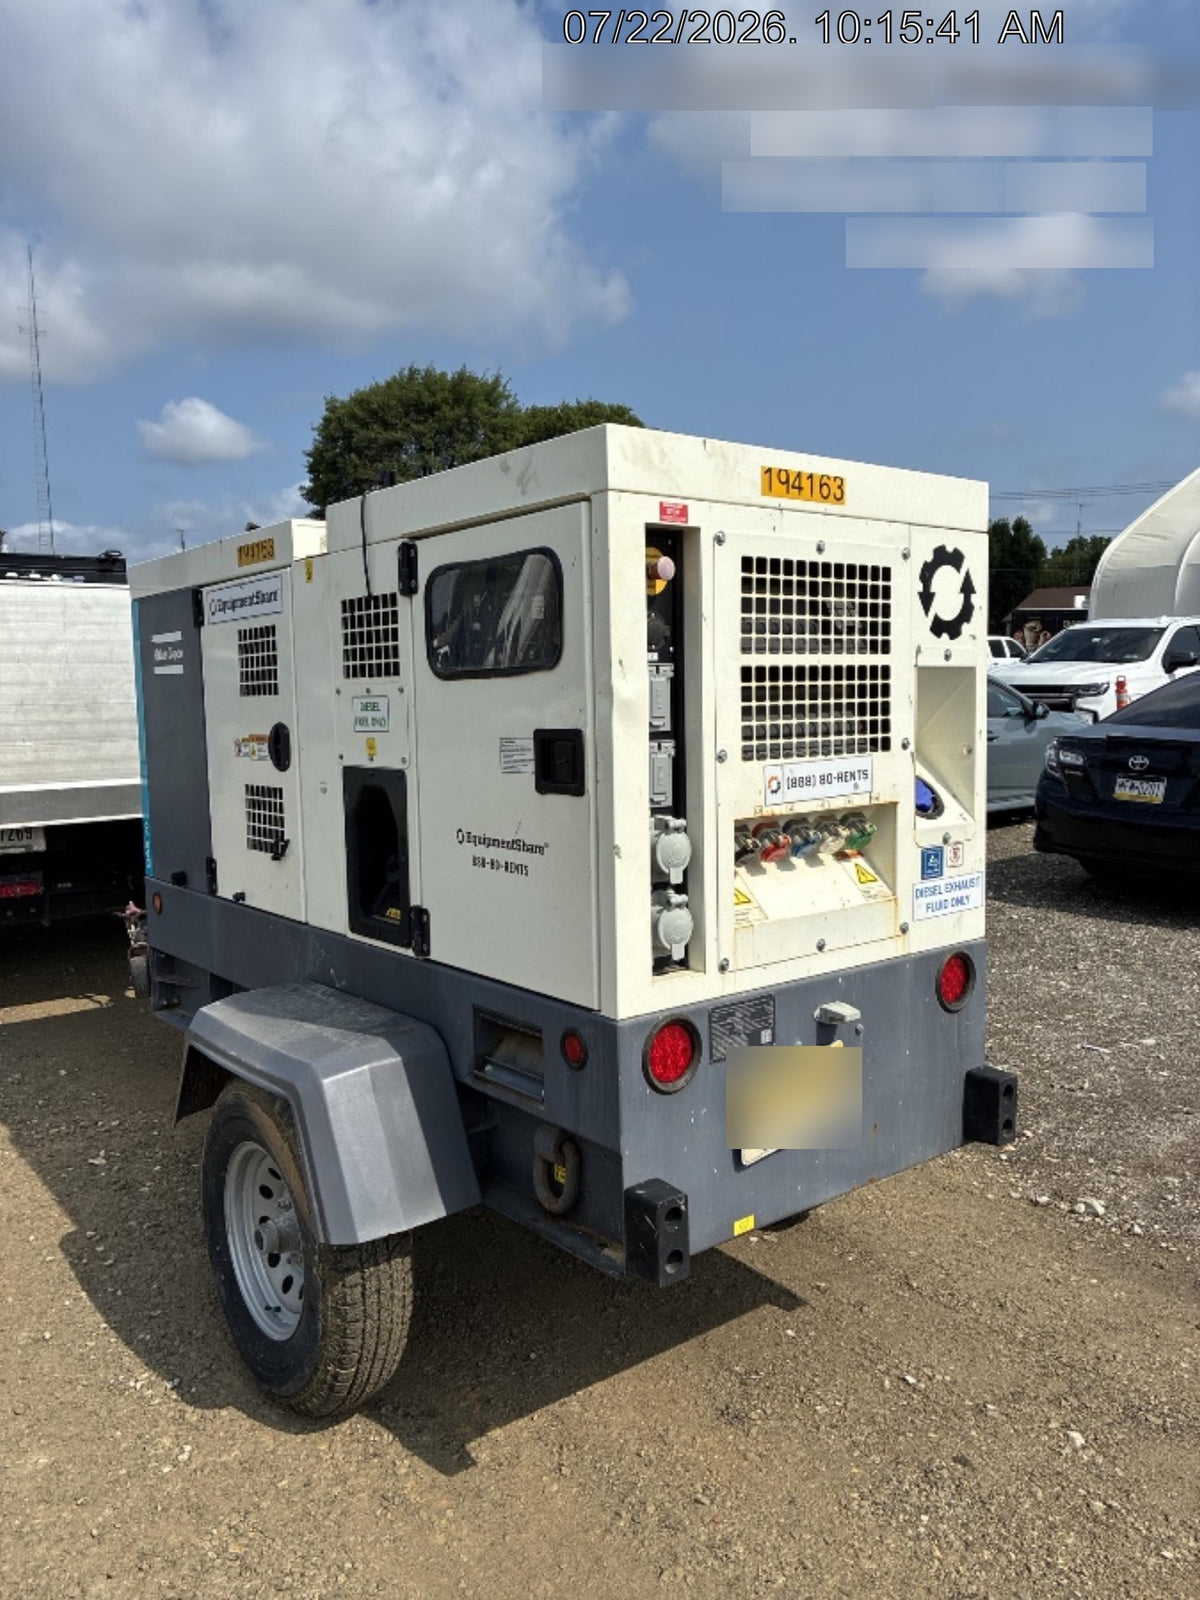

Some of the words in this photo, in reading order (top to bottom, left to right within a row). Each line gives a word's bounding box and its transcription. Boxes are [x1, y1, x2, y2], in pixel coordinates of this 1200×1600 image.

[764, 467, 845, 502] 194163
[915, 884, 943, 900] DIESEL
[945, 876, 981, 894] EXHAUST
[926, 898, 949, 914] FLUID
[951, 894, 972, 908] ONLY
